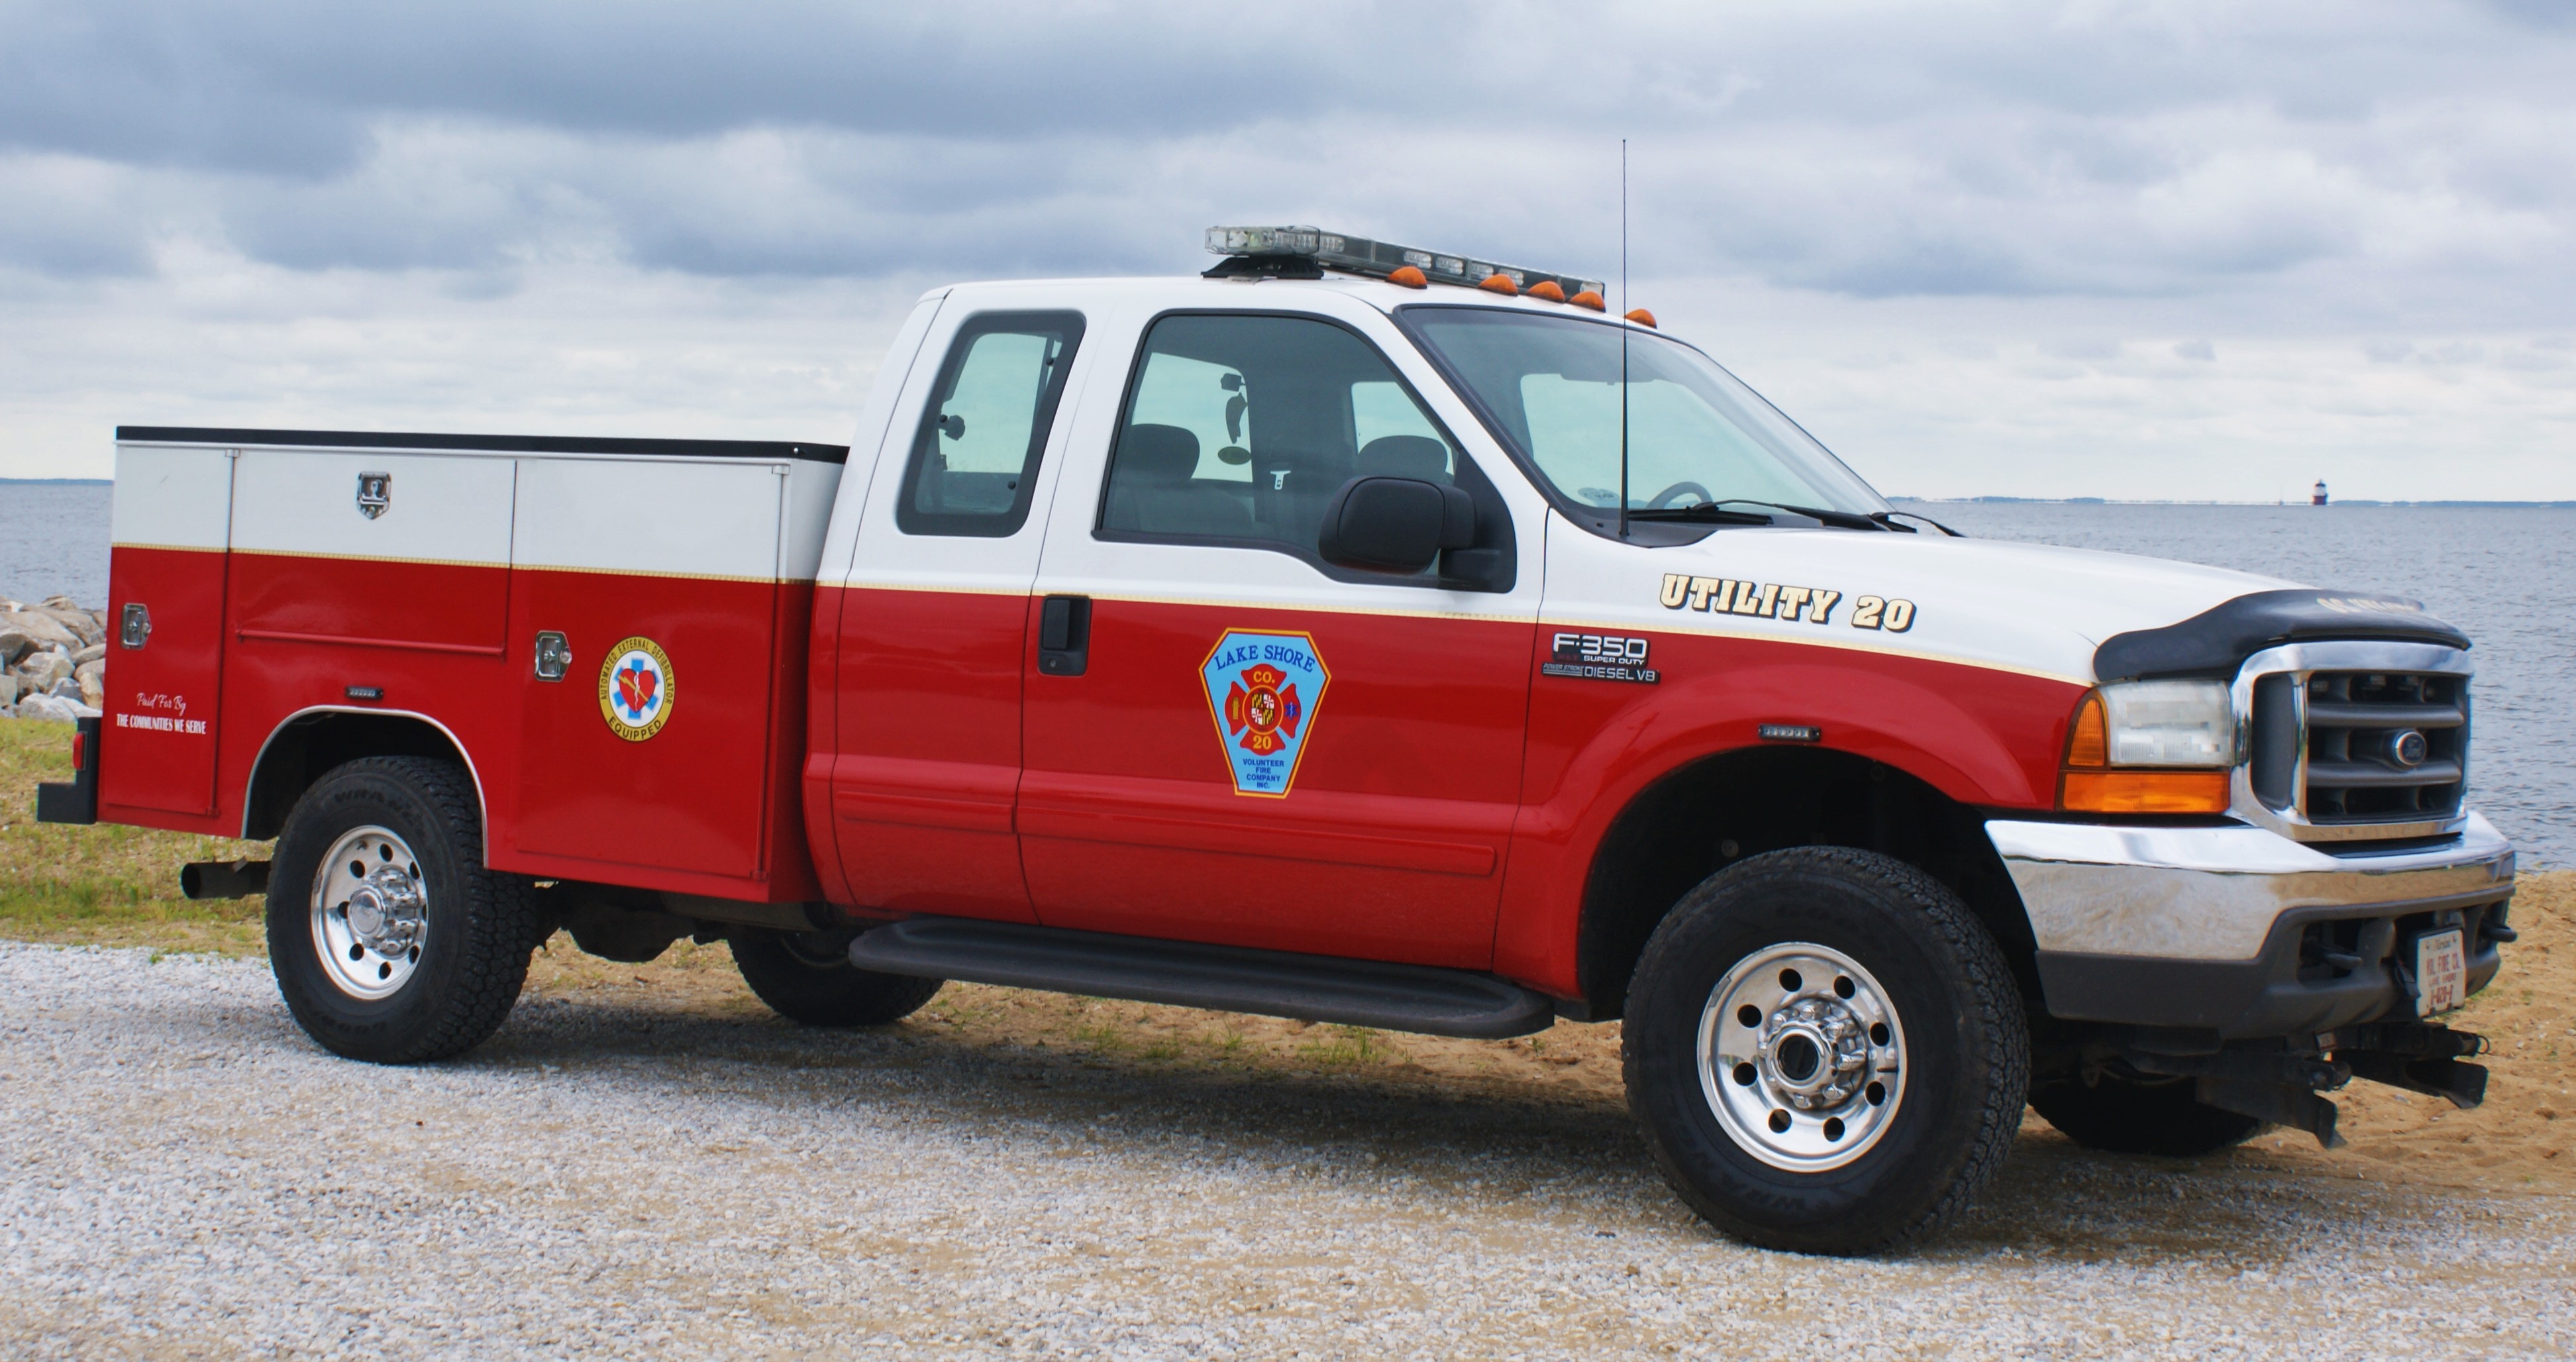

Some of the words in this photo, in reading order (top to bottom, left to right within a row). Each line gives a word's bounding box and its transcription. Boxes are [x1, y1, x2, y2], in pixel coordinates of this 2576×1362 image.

[1659, 573, 1843, 625] UTILITY
[1851, 595, 1917, 633] 20
[1213, 645, 1259, 671] LAKE
[1264, 645, 1315, 673] SHORE
[1584, 655, 1616, 664] SUPER
[600, 652, 617, 700] AUTOMATED
[617, 638, 649, 654] EXTERNAL
[651, 645, 675, 705] DEFIBRILLATOR
[1253, 671, 1275, 684] CO.
[1584, 666, 1634, 680] DIESEL
[1637, 670, 1656, 682] V8
[136, 692, 158, 709] Paid
[158, 694, 172, 709] For
[173, 696, 186, 717] By
[117, 713, 129, 727] THE
[130, 715, 173, 731] COMMUNITIES
[174, 719, 184, 733] WE
[185, 720, 207, 735] SERVE
[607, 715, 662, 740] EQUIPPED
[1253, 735, 1272, 750] 20
[1243, 758, 1284, 768] VOLUNTEER
